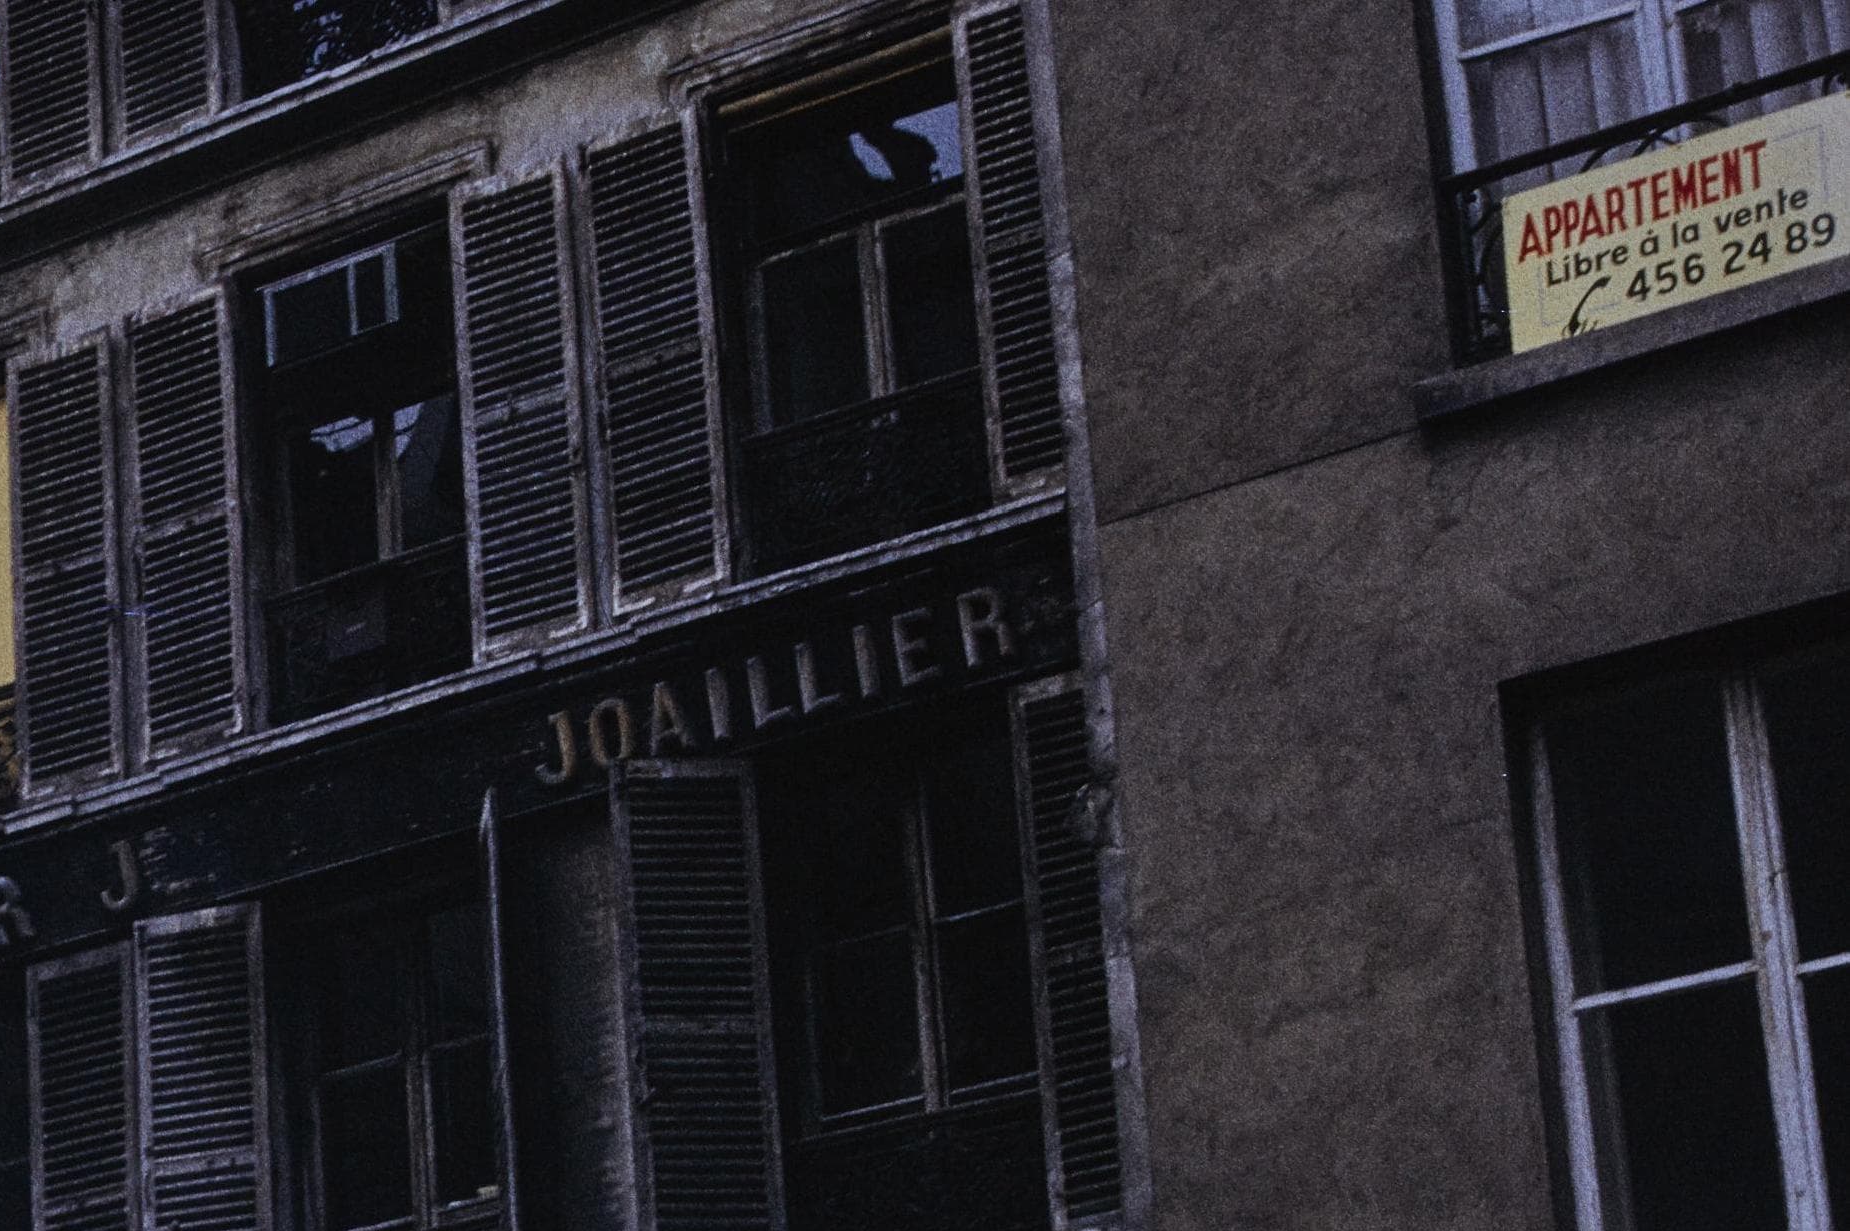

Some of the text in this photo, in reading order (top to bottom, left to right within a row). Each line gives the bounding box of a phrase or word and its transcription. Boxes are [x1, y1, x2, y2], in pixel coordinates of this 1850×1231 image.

[1518, 139, 1768, 263] APPARTEMENT
[1546, 188, 1810, 286] Libre à la vente
[1627, 213, 1837, 302] 456 24 89
[534, 586, 1016, 785] JOAILLIER
